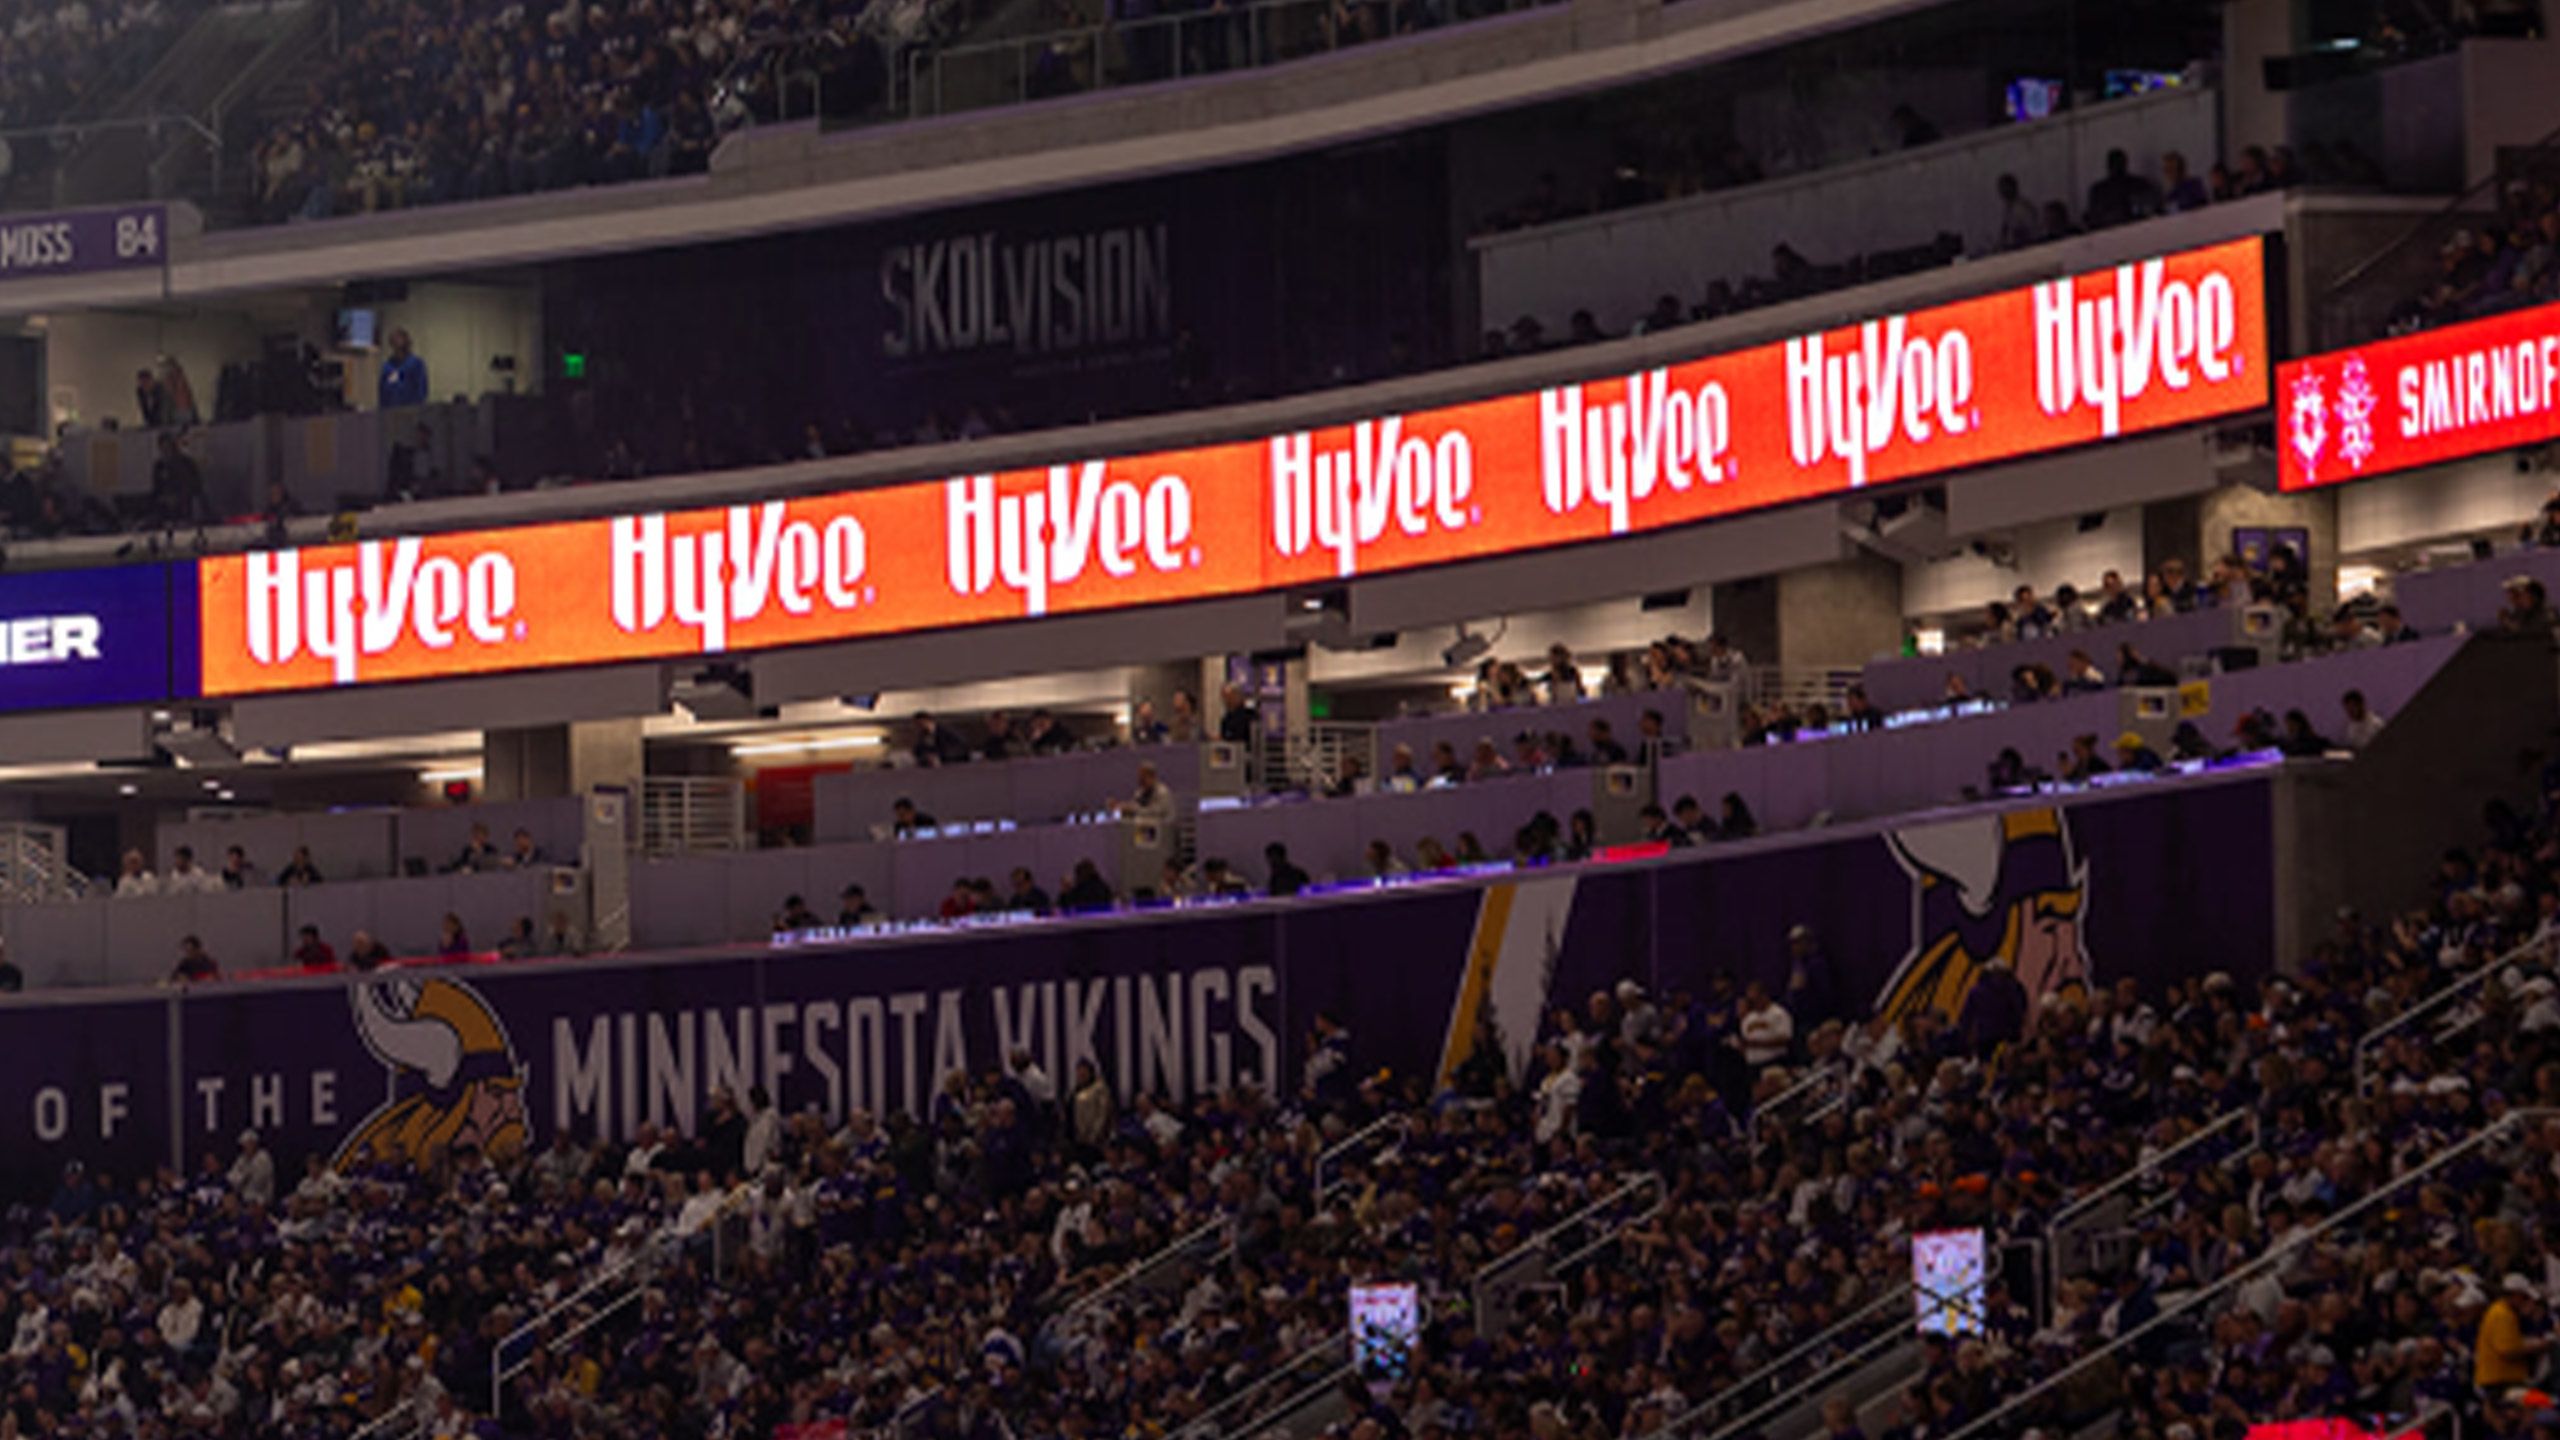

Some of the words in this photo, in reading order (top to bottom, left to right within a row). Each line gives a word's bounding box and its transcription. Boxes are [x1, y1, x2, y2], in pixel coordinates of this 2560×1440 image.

[1, 221, 74, 269] MOSS
[115, 213, 158, 258] 84
[880, 224, 1171, 354] SKOLVISION
[553, 990, 966, 1140] MINNESOTA
[993, 965, 1278, 1102] VIKINGS
[35, 1083, 127, 1141] OF
[197, 1071, 337, 1132] THE
